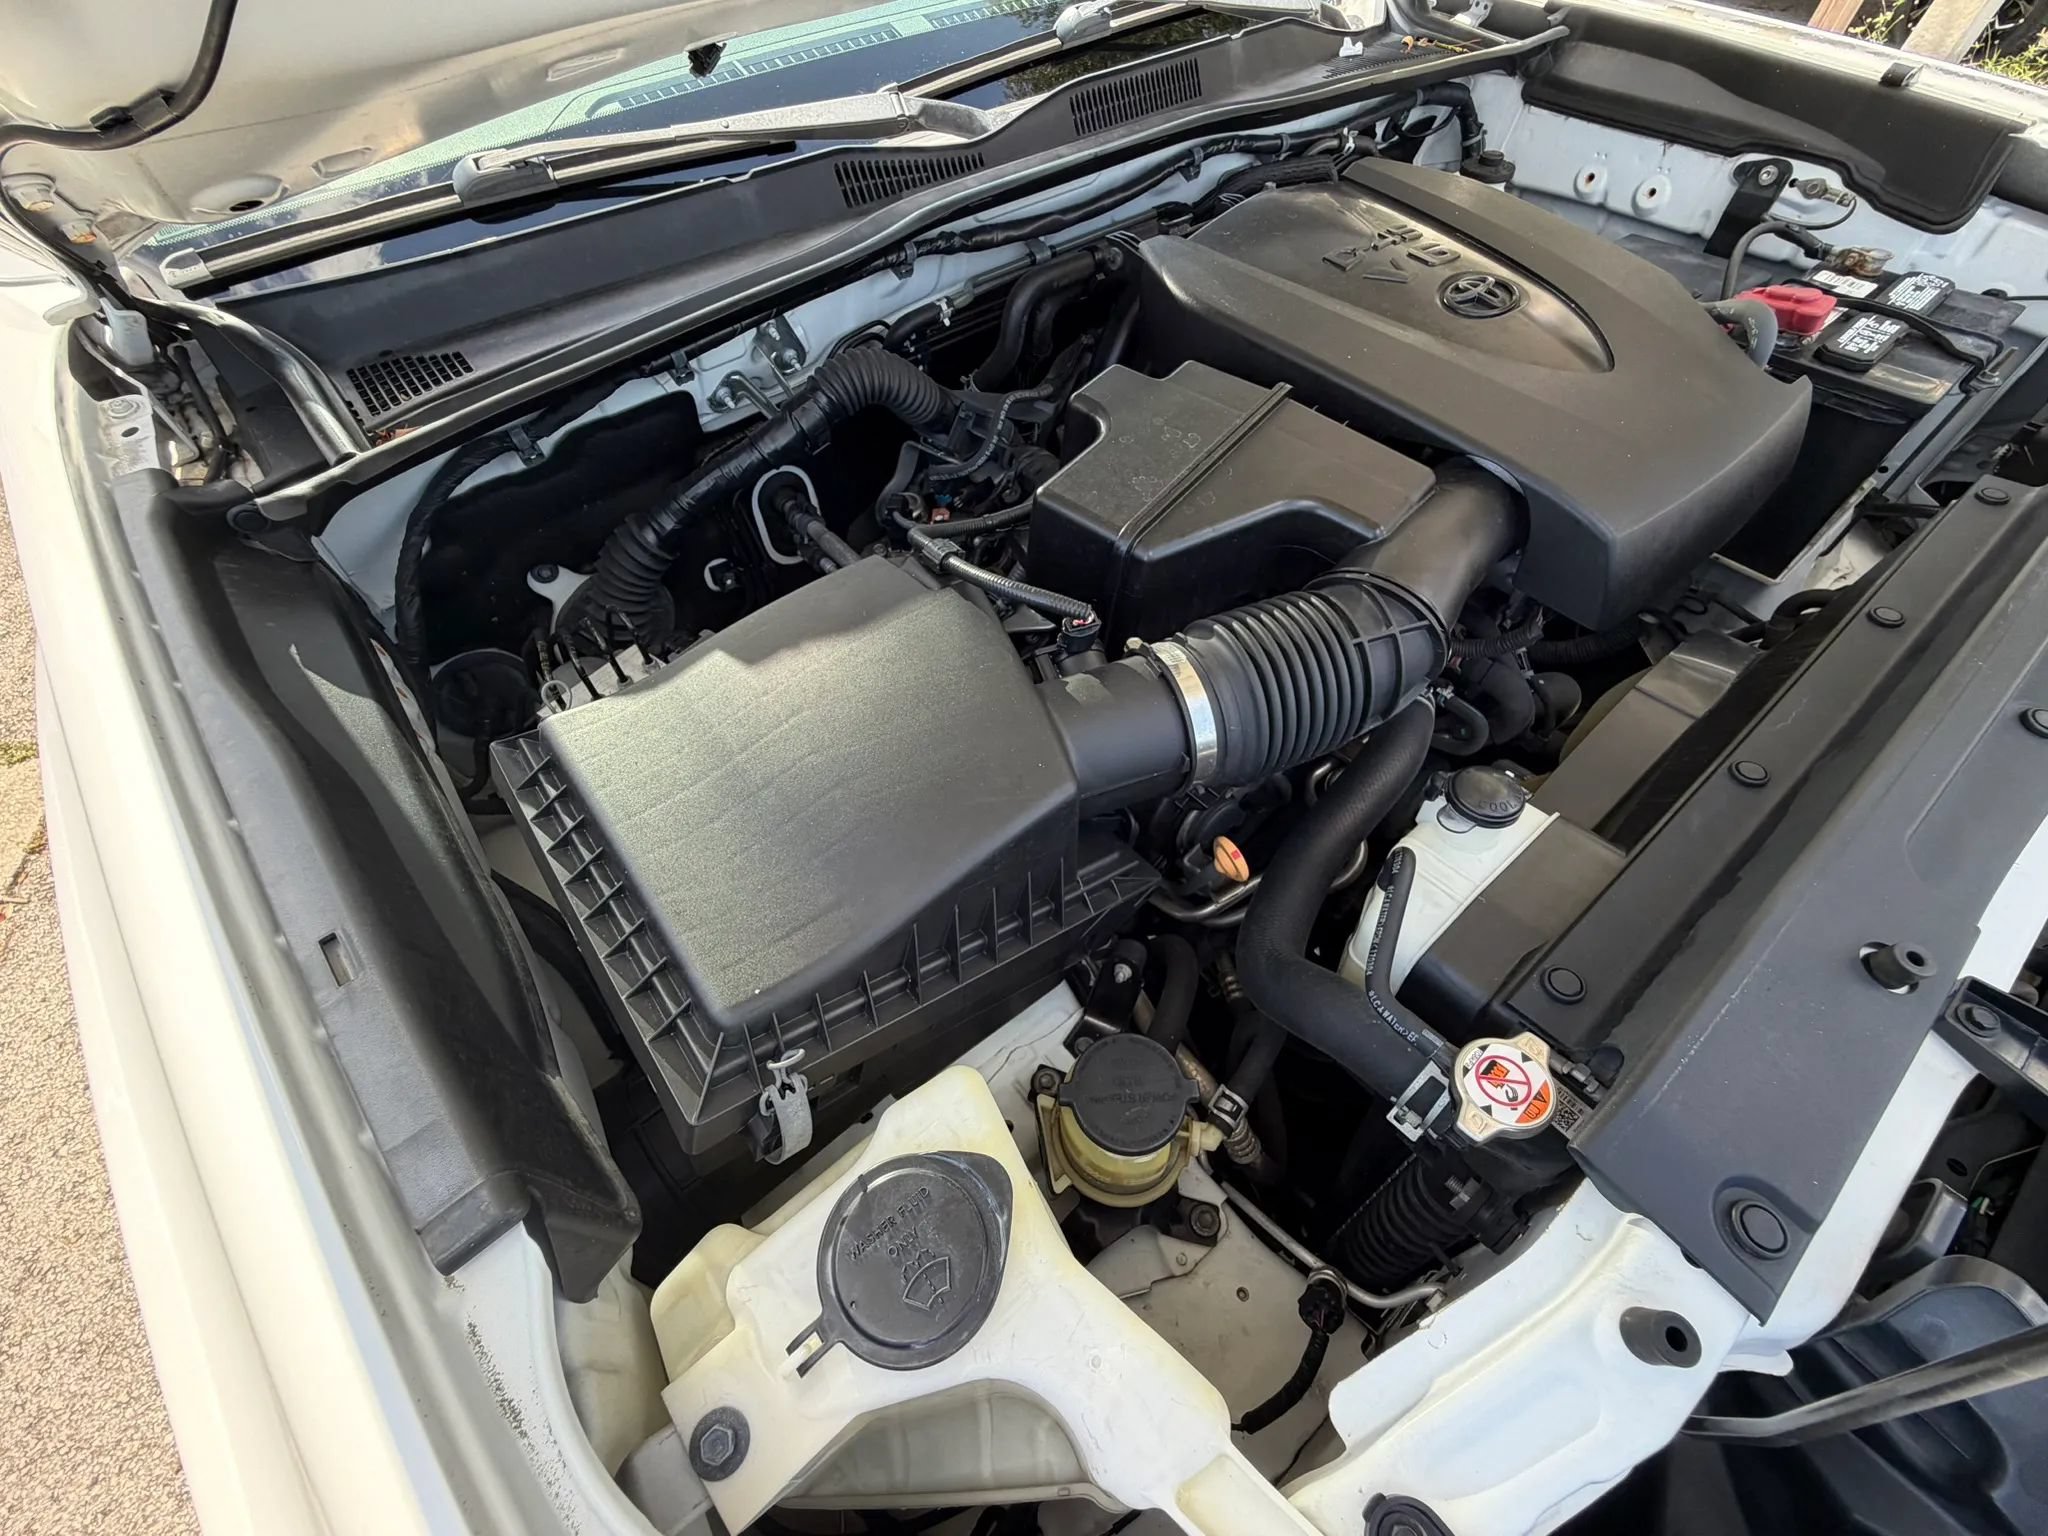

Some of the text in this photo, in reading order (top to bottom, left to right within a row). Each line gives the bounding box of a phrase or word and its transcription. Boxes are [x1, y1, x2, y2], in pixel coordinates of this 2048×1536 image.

[1363, 242, 1461, 283] V6
[847, 1186, 929, 1261] WASHER FLUID
[887, 1226, 919, 1258] ONLY
